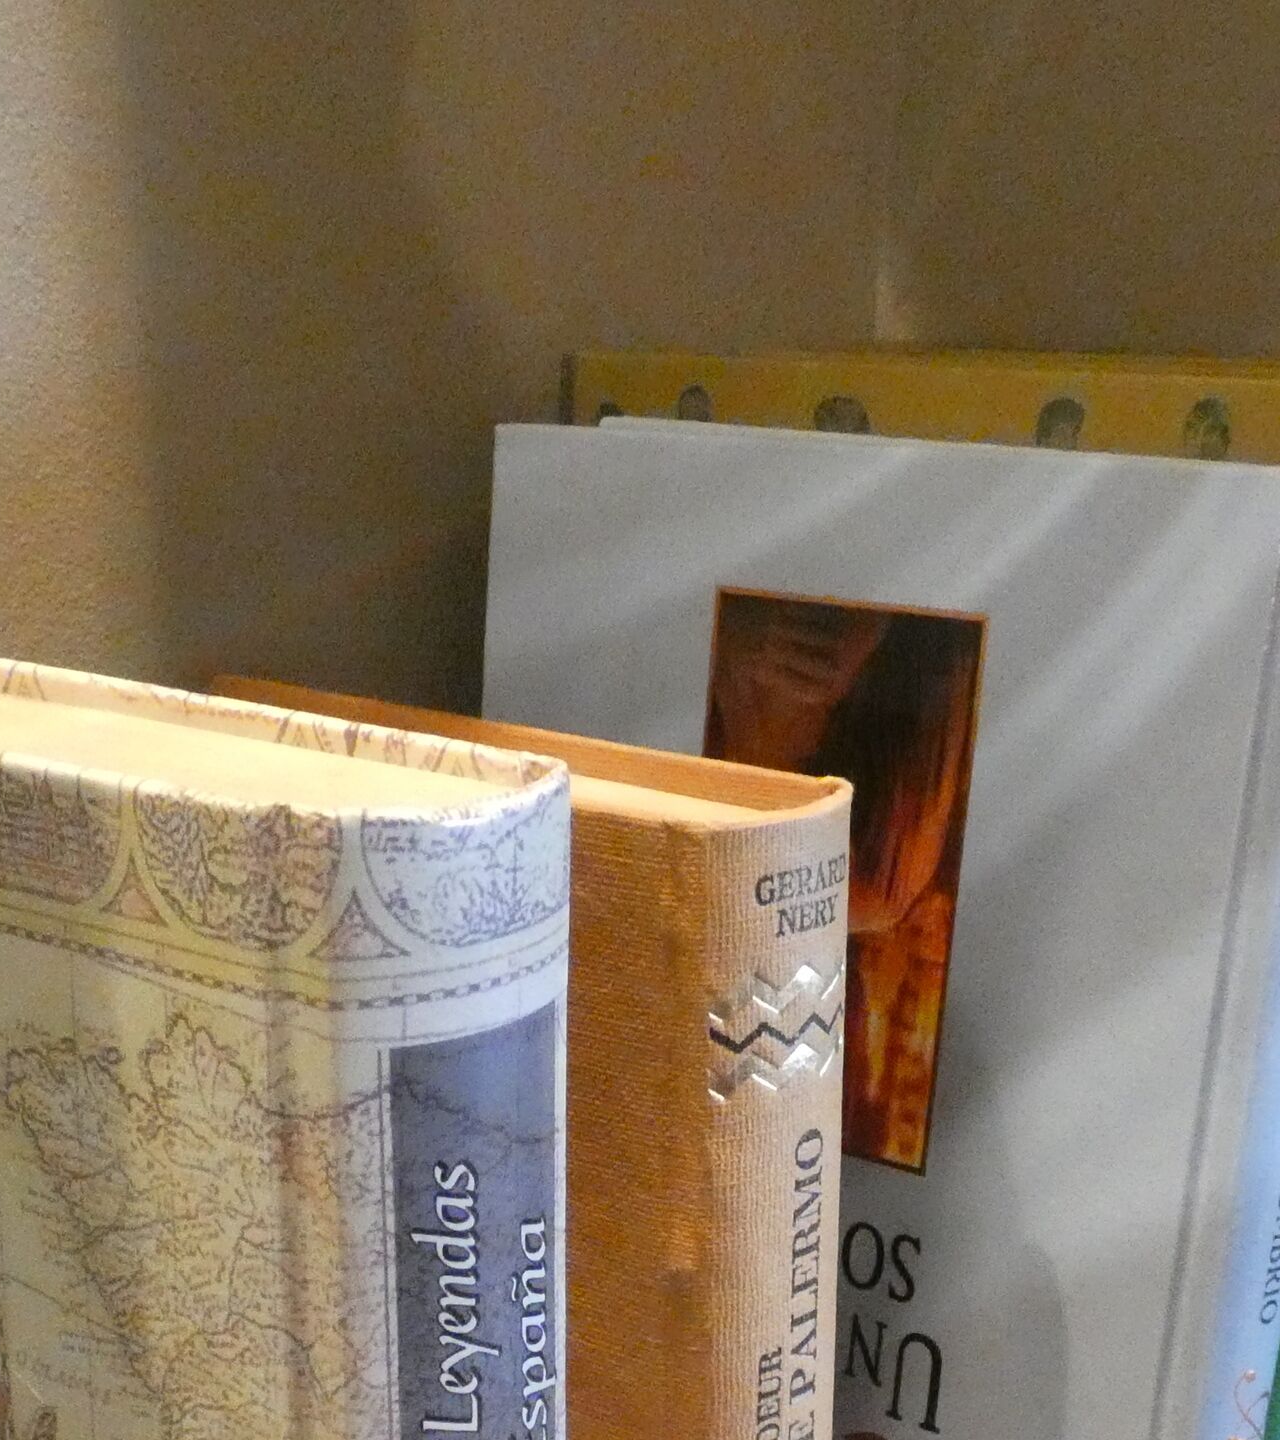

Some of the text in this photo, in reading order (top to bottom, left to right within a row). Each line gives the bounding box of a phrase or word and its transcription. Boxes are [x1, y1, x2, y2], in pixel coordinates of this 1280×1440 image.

[775, 894, 839, 938] NERY
[410, 1162, 501, 1433] Leyendas
[790, 1127, 824, 1406] PALERMO
